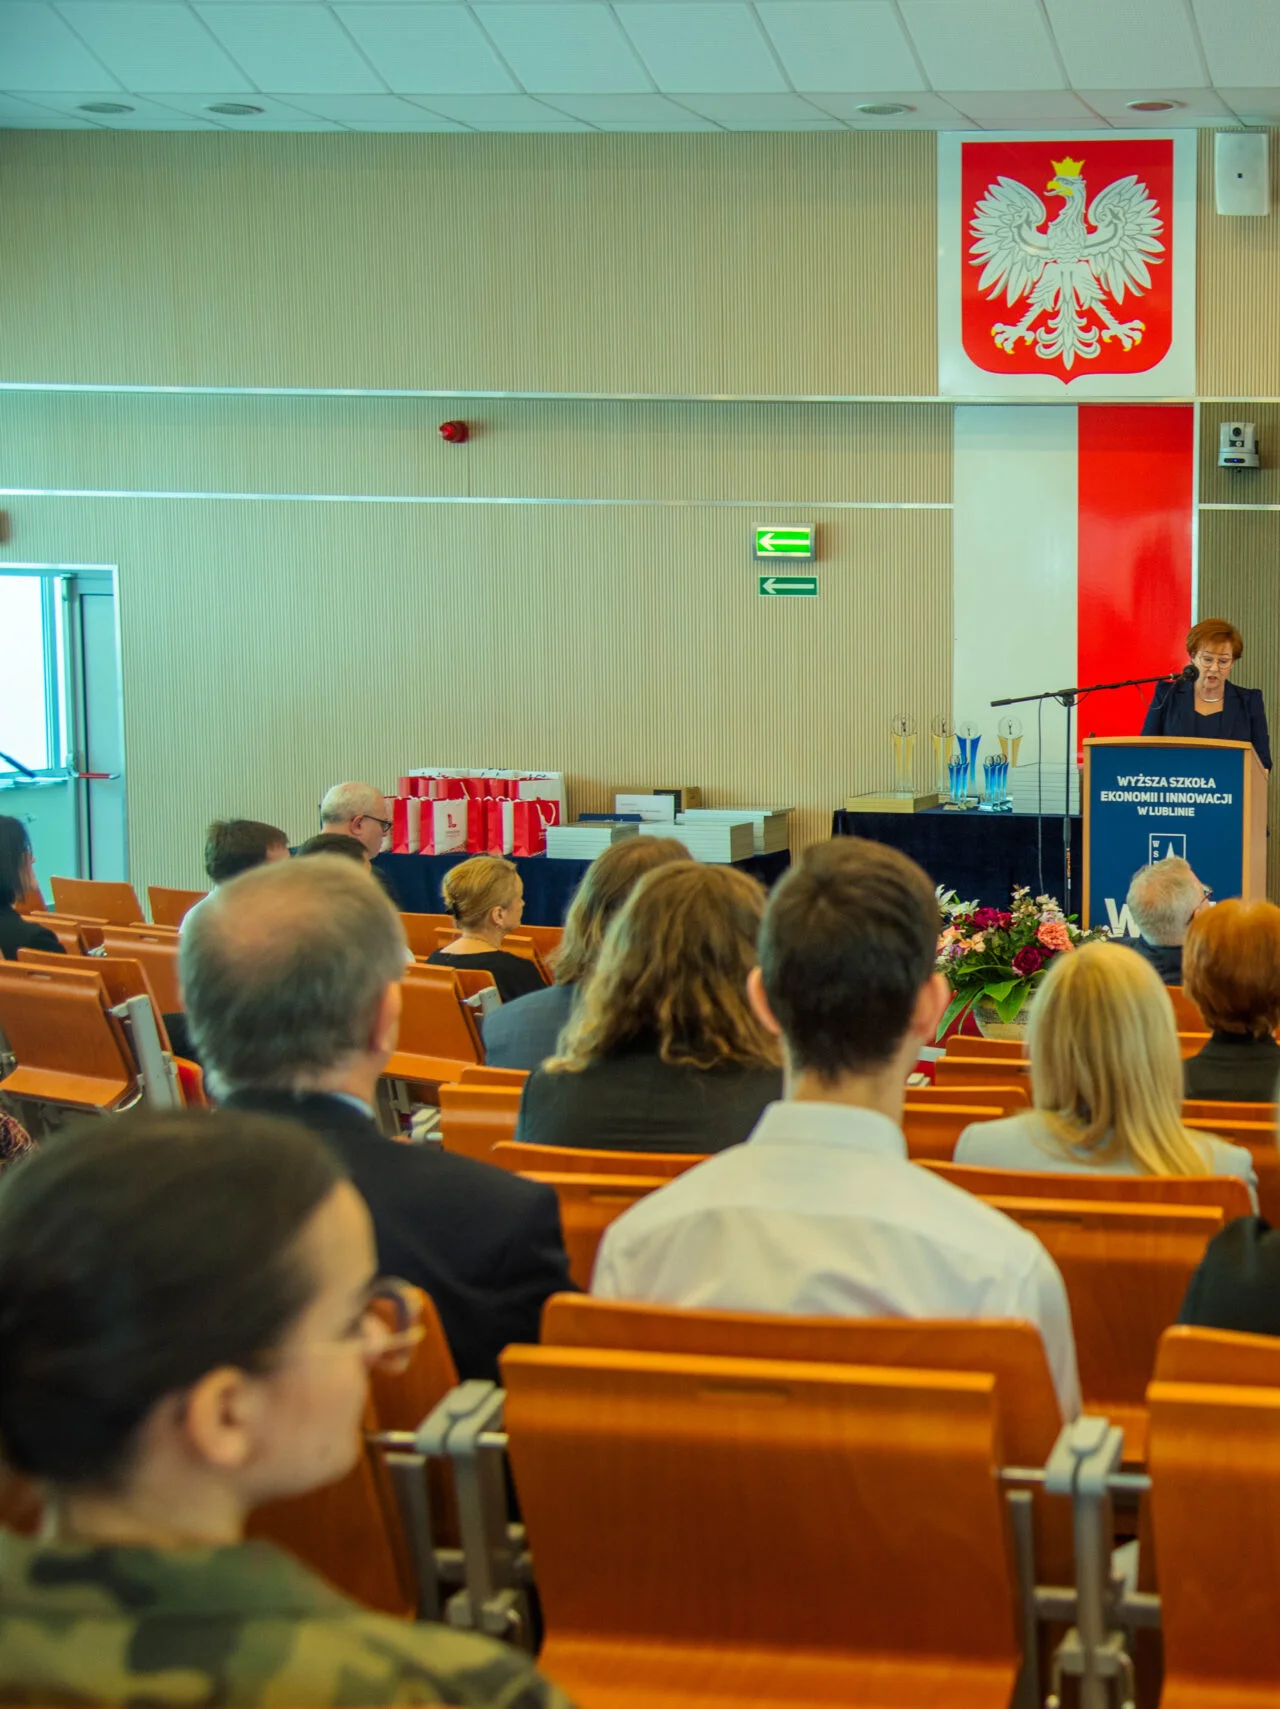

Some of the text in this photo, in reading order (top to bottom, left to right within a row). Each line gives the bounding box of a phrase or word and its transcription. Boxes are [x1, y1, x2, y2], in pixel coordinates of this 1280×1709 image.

[1117, 774, 1216, 788] WYŻSZA SZKOŁA
[1101, 791, 1232, 804] EKONOMII I INNOWACJI
[1137, 806, 1194, 816] W LUBLINIE
